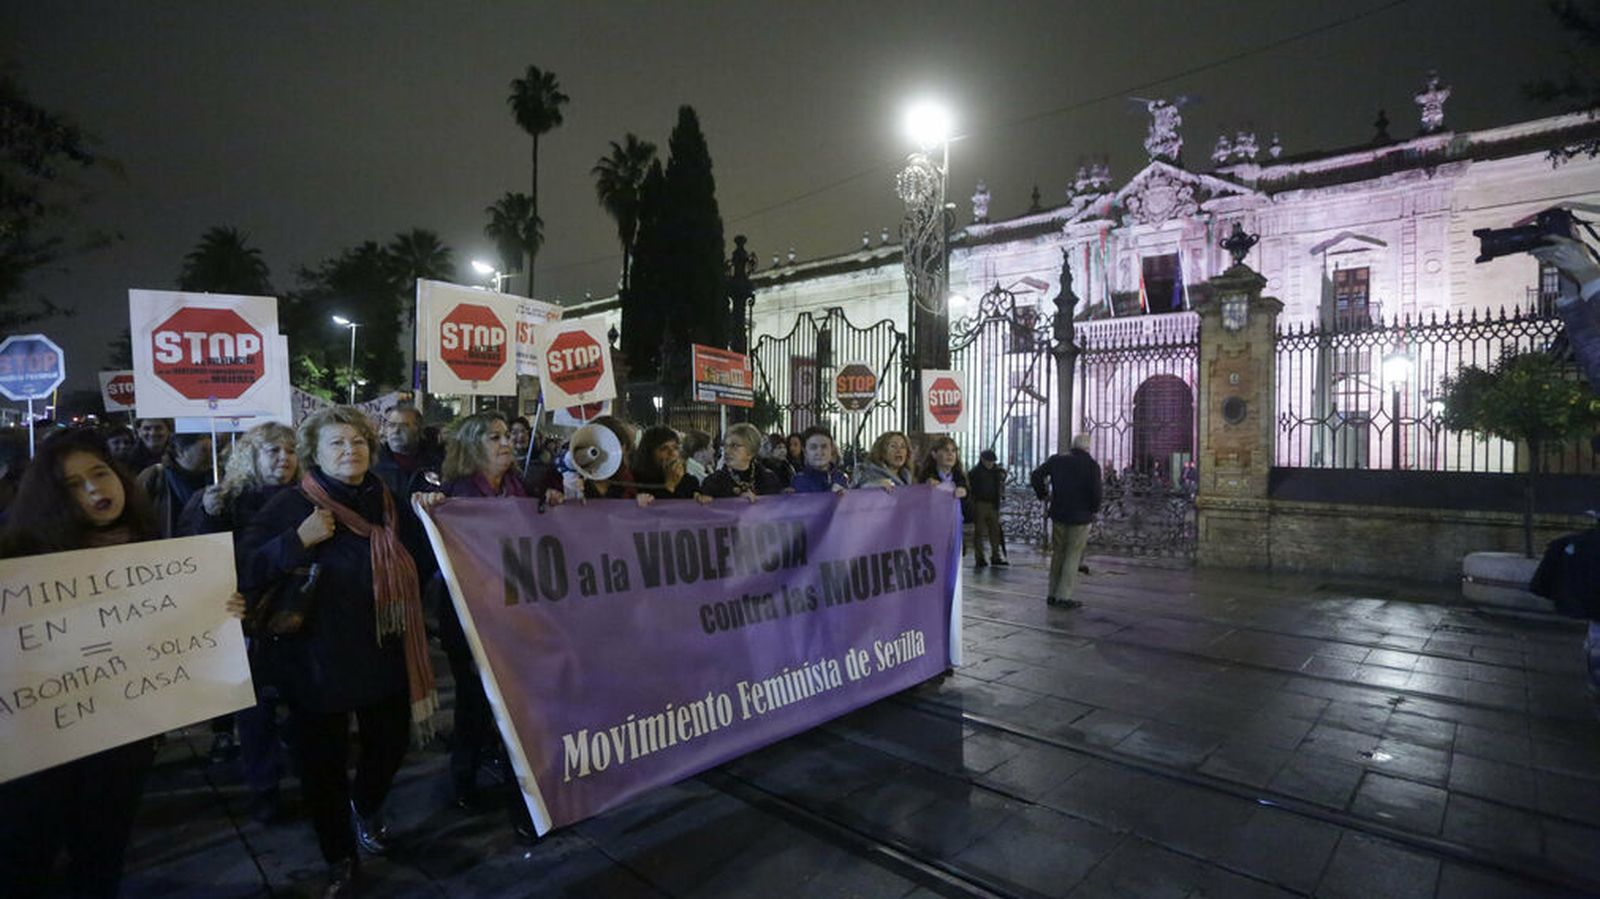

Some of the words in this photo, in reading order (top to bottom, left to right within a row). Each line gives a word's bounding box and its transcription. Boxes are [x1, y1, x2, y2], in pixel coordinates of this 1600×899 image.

[154, 331, 262, 364] STOP
[442, 322, 505, 351] STOP
[0, 351, 57, 373] STOP
[548, 345, 601, 374] STOP
[837, 375, 875, 392] STOP
[929, 389, 962, 406] STOP
[502, 535, 569, 606] NO
[577, 561, 598, 597] a
[601, 553, 631, 594] la
[633, 521, 809, 588] VIOLENCIA
[1, 557, 197, 615] MINICIDIOS
[700, 591, 780, 634] contra
[783, 584, 819, 617] las
[819, 544, 937, 607] MUJERES
[19, 618, 67, 651] EN
[99, 594, 178, 628] MASA
[147, 631, 218, 661] SOLAS
[54, 698, 95, 729] EN
[124, 665, 191, 699] CASA
[562, 691, 733, 782] Movimiento
[736, 658, 843, 720] Feminista
[845, 648, 871, 681] de
[874, 629, 926, 672] Sevilla
